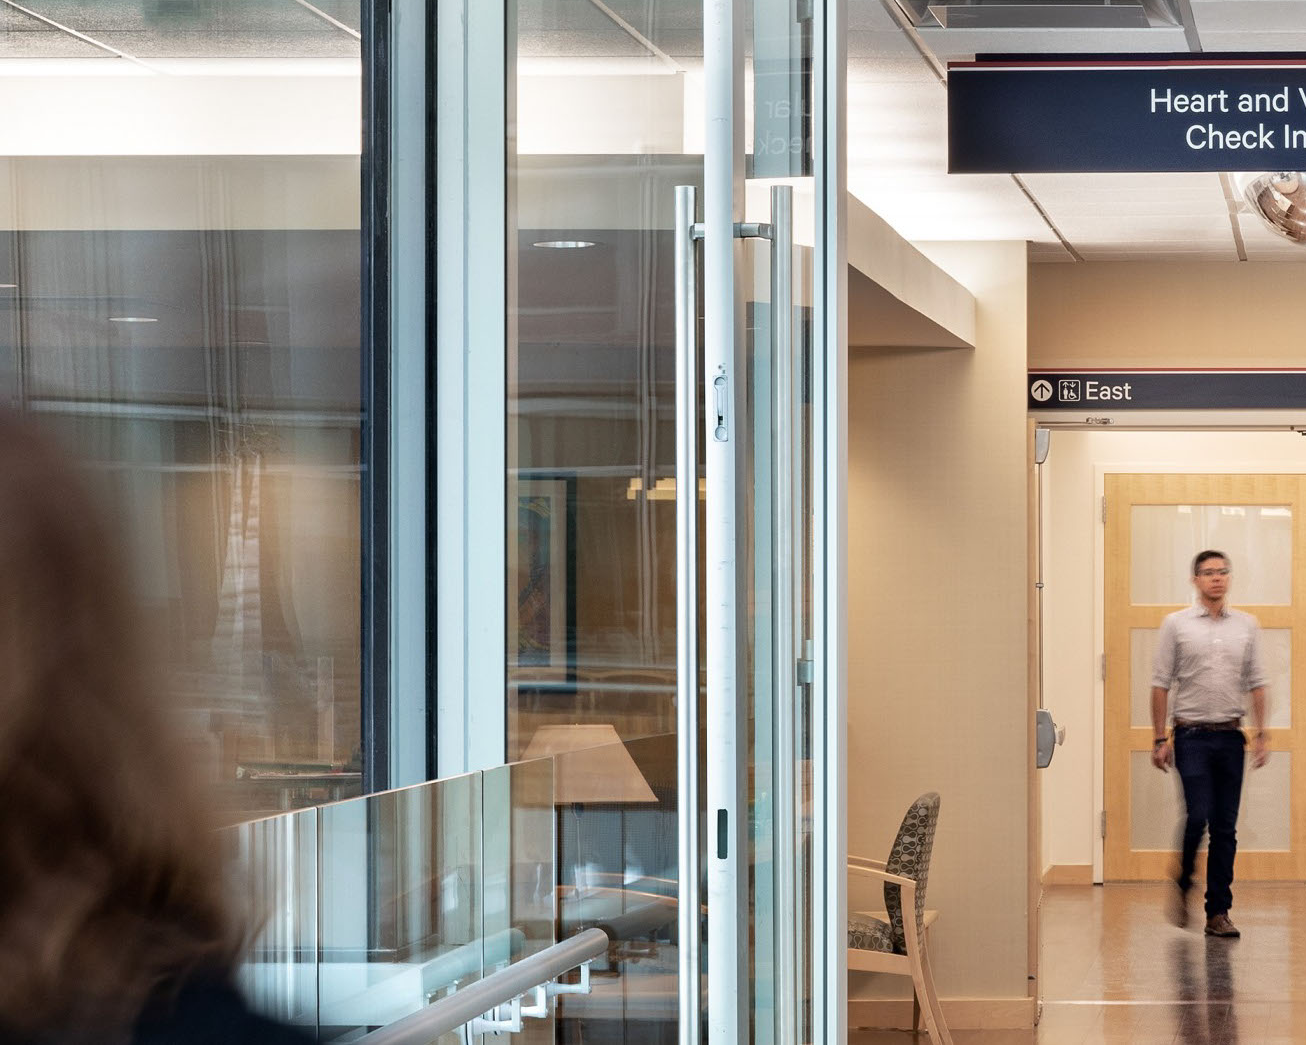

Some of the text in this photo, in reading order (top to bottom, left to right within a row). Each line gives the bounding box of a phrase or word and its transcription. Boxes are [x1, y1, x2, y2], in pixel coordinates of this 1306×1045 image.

[1150, 88, 1230, 114] Heart
[1237, 85, 1289, 113] and
[1185, 122, 1276, 150] Check
[1086, 381, 1132, 401] East
